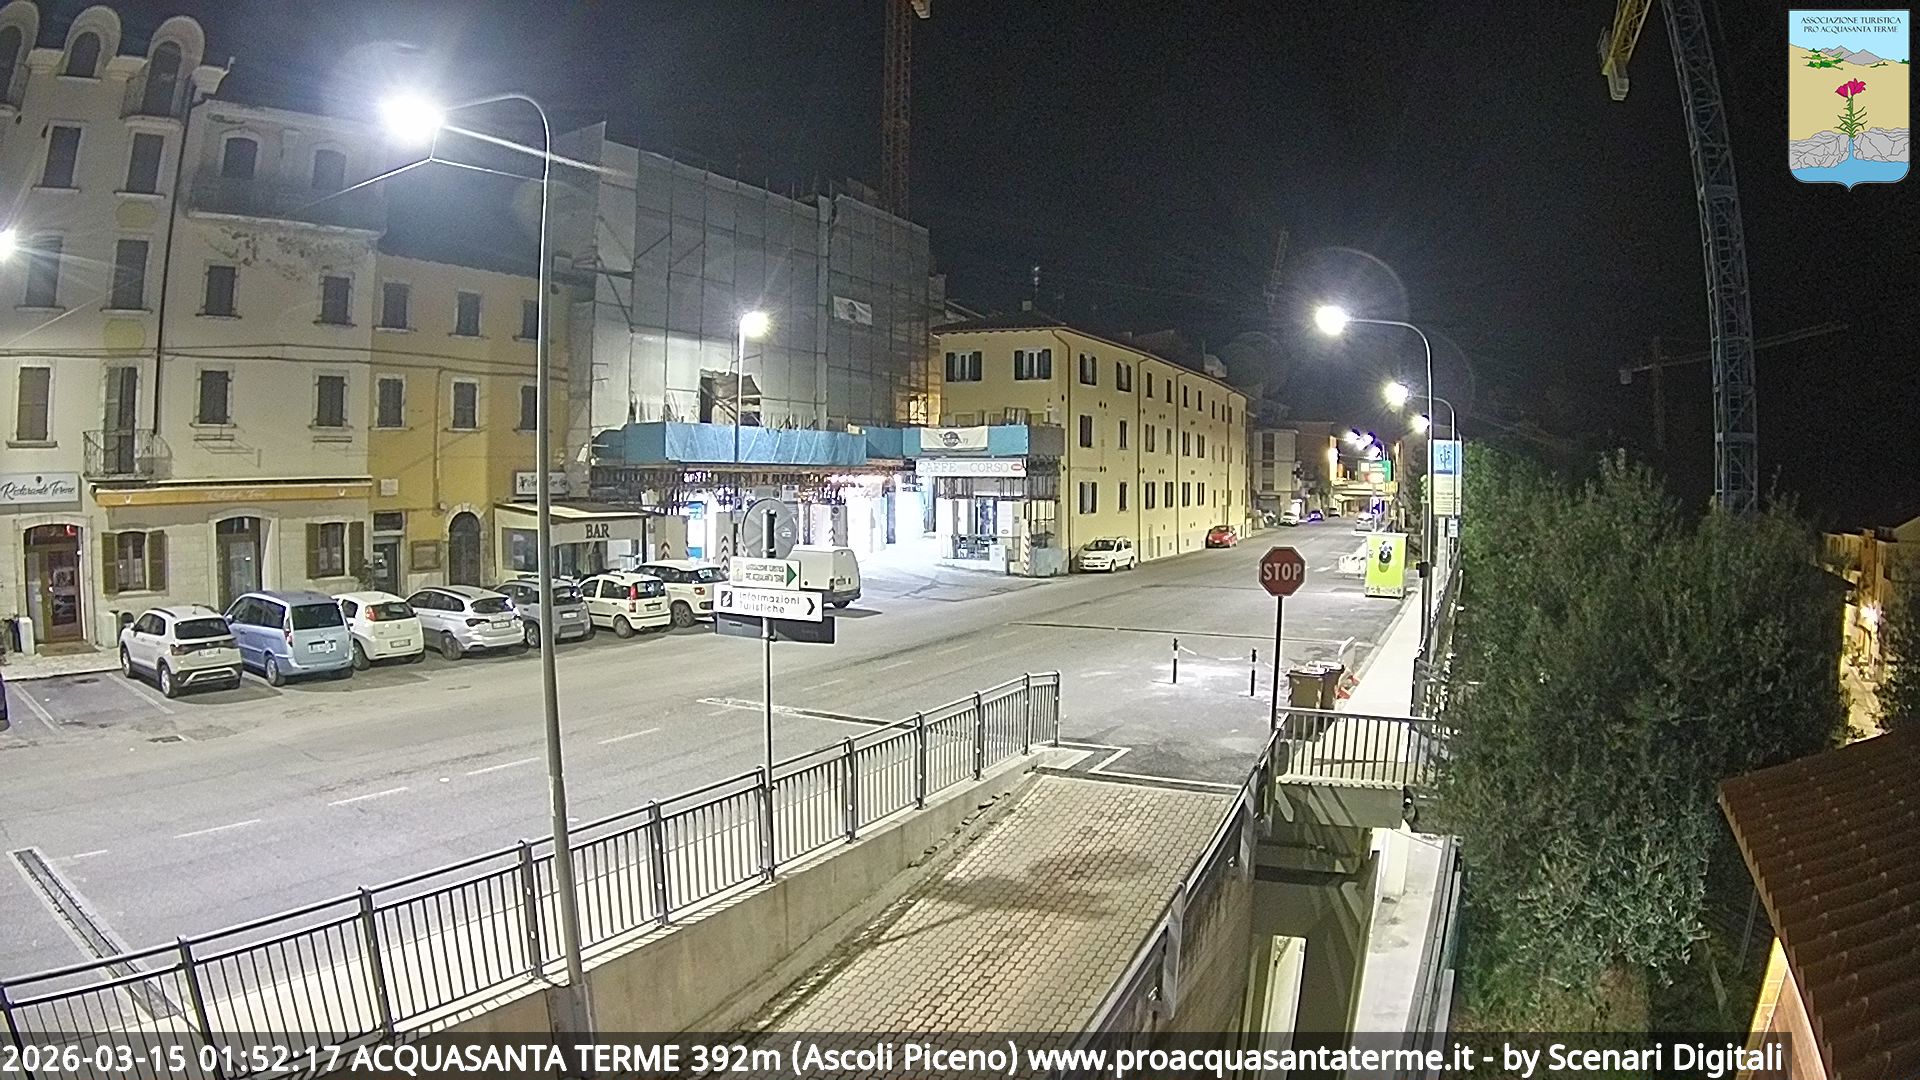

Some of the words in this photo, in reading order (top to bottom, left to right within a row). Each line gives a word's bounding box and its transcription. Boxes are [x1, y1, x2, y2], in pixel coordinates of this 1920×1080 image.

[969, 462, 1010, 473] CORSO
[585, 523, 610, 539] BAR
[1263, 562, 1302, 581] STOP
[739, 591, 800, 605] Informazioni
[739, 601, 785, 614] Turistiche
